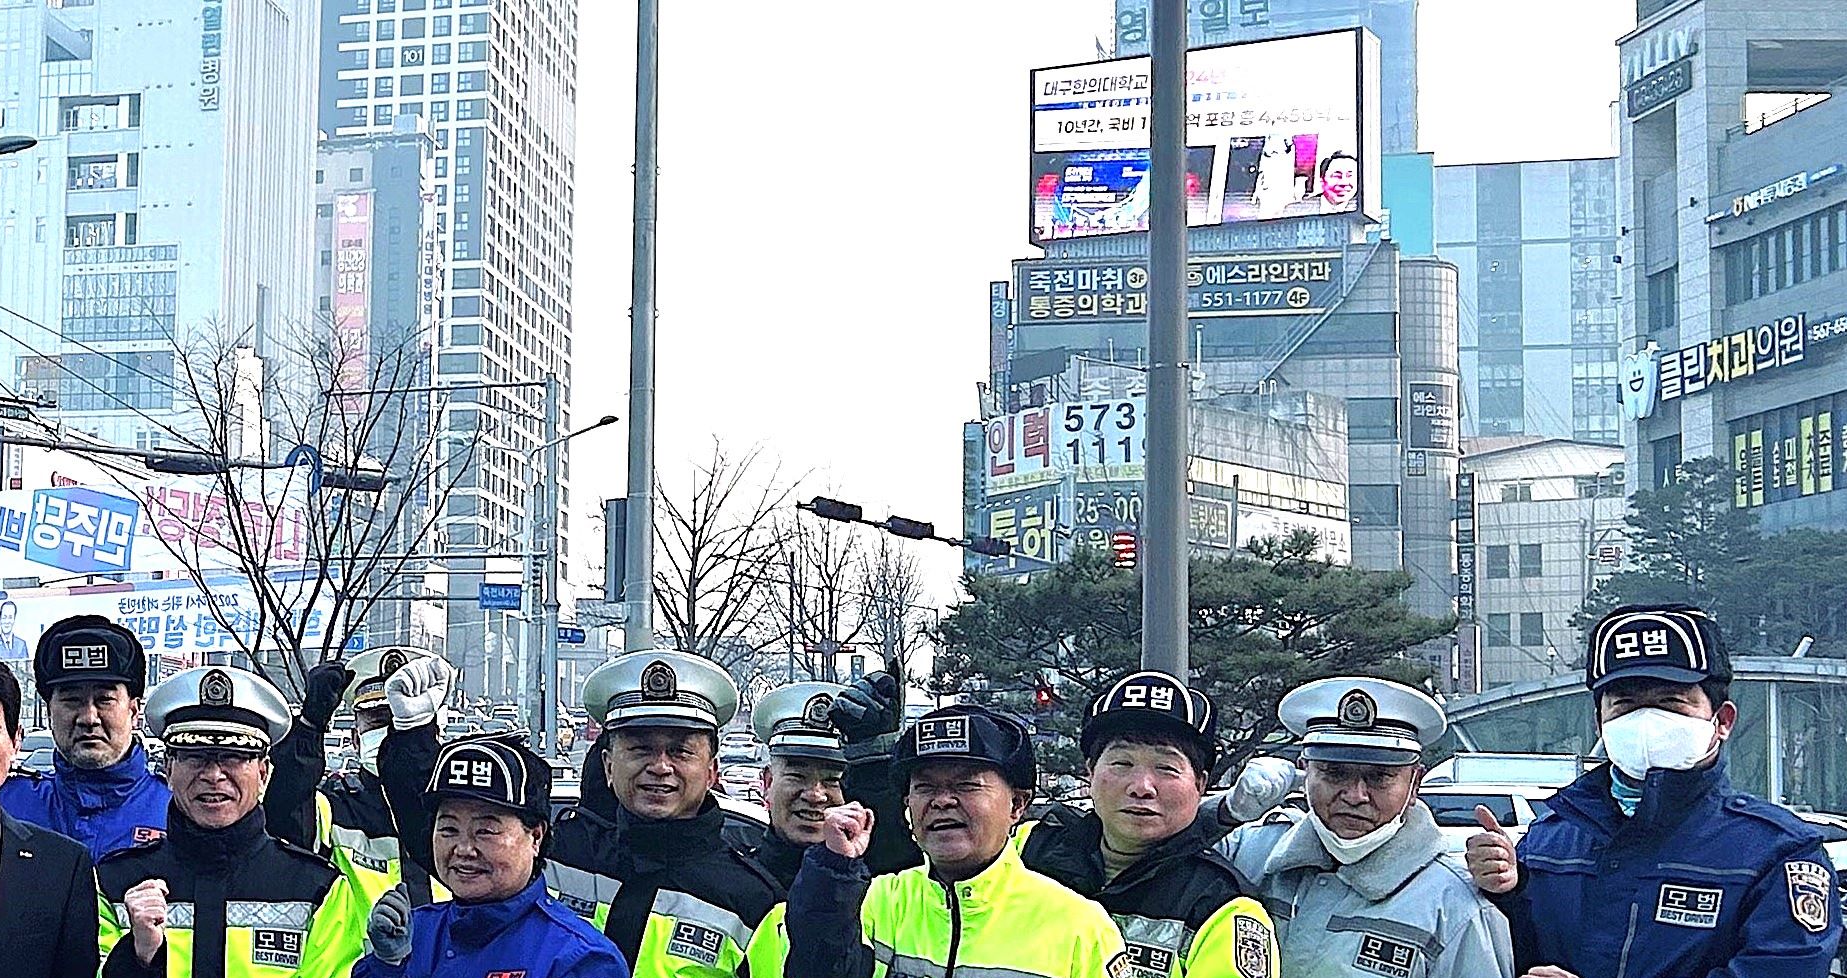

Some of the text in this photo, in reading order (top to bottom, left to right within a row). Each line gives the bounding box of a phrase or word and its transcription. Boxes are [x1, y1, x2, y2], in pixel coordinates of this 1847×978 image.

[403, 49, 424, 64] 101
[1205, 262, 1332, 286] 에스라인치과
[1660, 314, 1804, 401] 클린치과의원
[988, 405, 1050, 477] 인력
[65, 646, 106, 667] 모범
[1614, 627, 1669, 660] 모범
[1121, 683, 1175, 711] 모범
[922, 720, 962, 740] 모범
[449, 758, 492, 788] 모범
[1665, 890, 1716, 911] 모범
[257, 931, 298, 951] 모범
[676, 924, 720, 951] 모범
[1127, 945, 1169, 970] 모범
[1364, 938, 1411, 966] 모범
